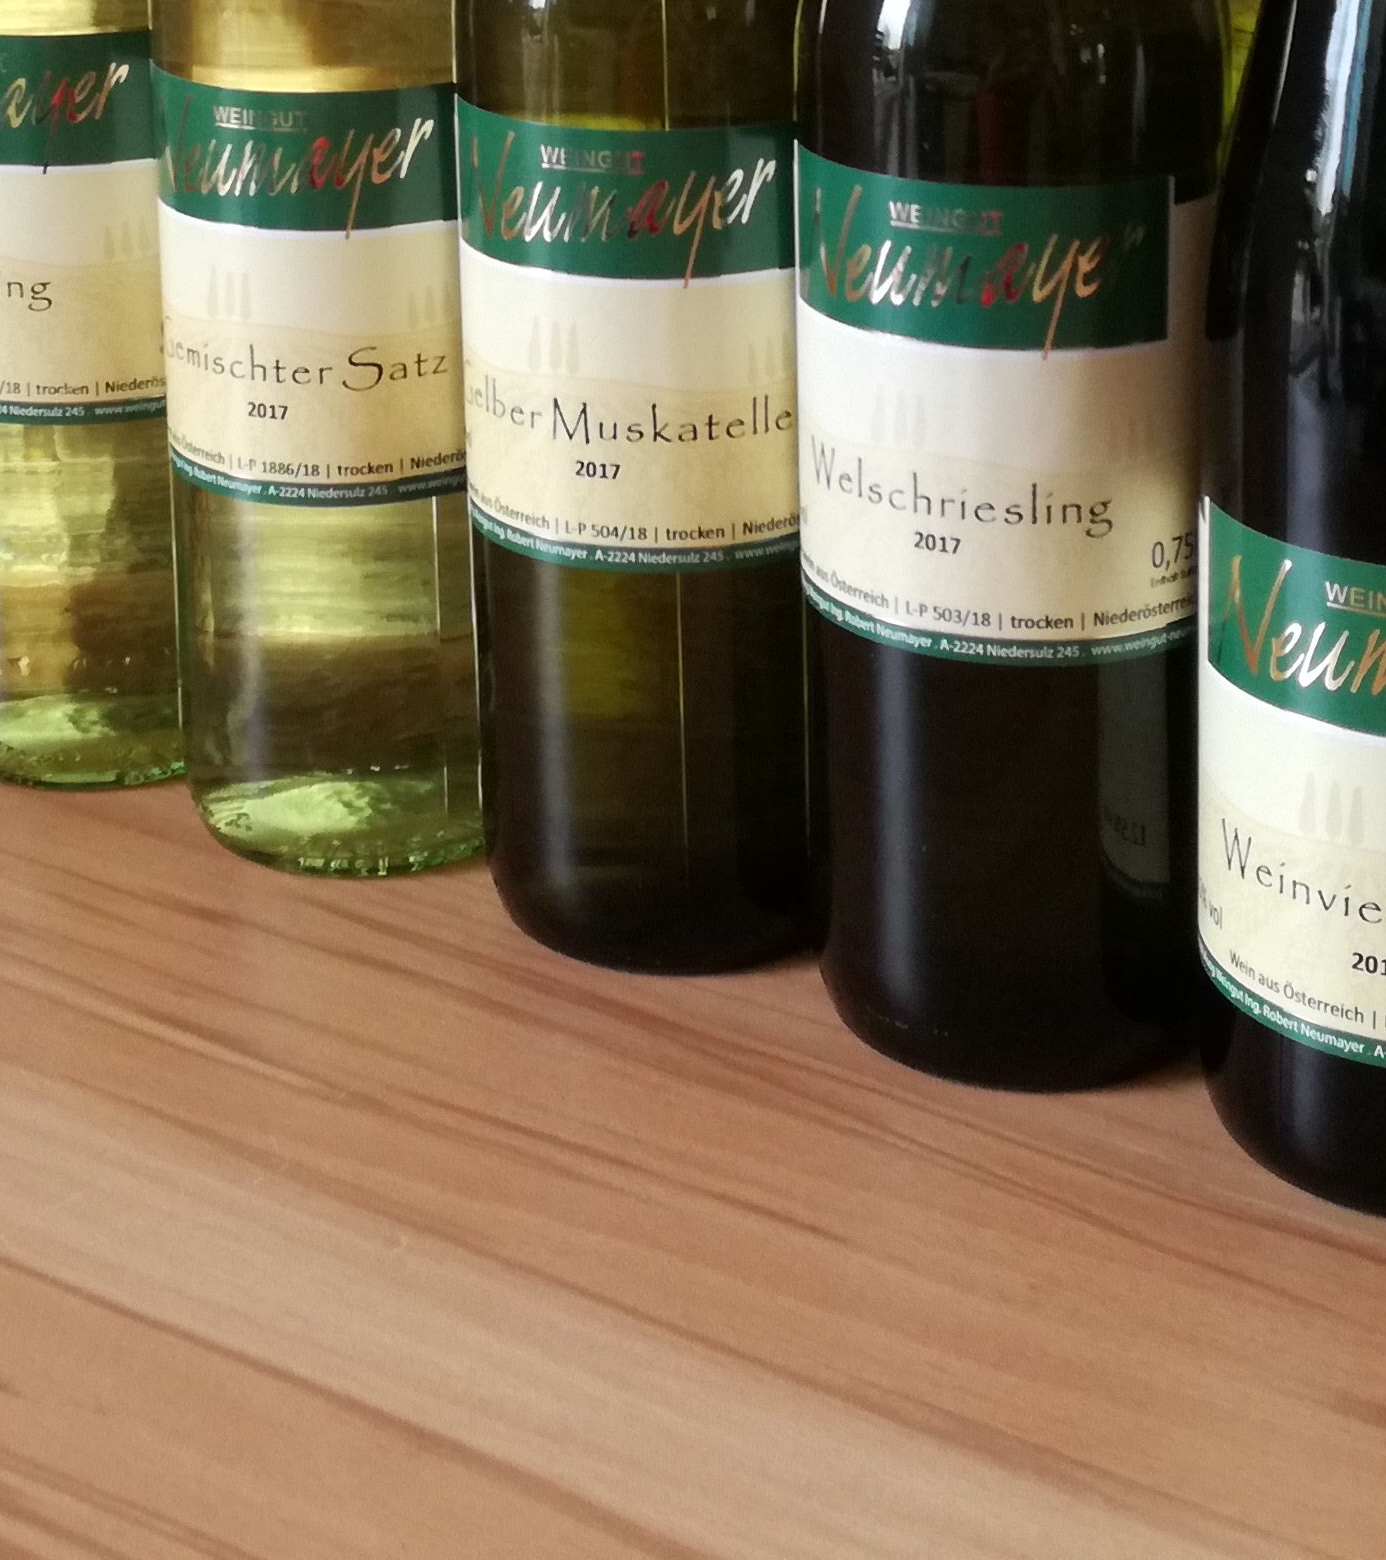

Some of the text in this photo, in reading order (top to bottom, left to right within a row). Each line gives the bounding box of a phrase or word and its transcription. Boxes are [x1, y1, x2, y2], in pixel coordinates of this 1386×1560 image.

[540, 144, 645, 173] WEINGUT
[888, 200, 1005, 234] WEINGUT
[342, 345, 448, 391] Satz
[35, 380, 89, 394] trocken
[247, 401, 289, 421] 2017
[261, 460, 320, 477] 1886/18
[337, 462, 394, 477] trocken
[574, 459, 621, 480] 2017
[268, 485, 305, 498] A-2224
[811, 433, 1114, 538] Welschriesling
[494, 496, 550, 530] Österreich
[565, 520, 587, 536] L-P
[591, 524, 648, 541] 504/18
[666, 524, 725, 541] trocken
[595, 548, 637, 562] A-2224
[638, 550, 701, 564] Niedersulz
[913, 531, 961, 554] 2017
[830, 570, 890, 609] Österreich
[906, 600, 928, 617] L-P
[933, 604, 992, 628] 503/18
[1010, 613, 1074, 630] trocken
[876, 622, 932, 648] Neumayer
[940, 638, 984, 655] A-2224
[987, 641, 1054, 659] Niedersulz
[1057, 641, 1080, 657] 245
[1229, 948, 1256, 981] Wein
[1258, 970, 1281, 994] aus
[1283, 980, 1364, 1024] Österreich
[1263, 1004, 1300, 1035] Robert
[1300, 1024, 1365, 1055] Neumayer
